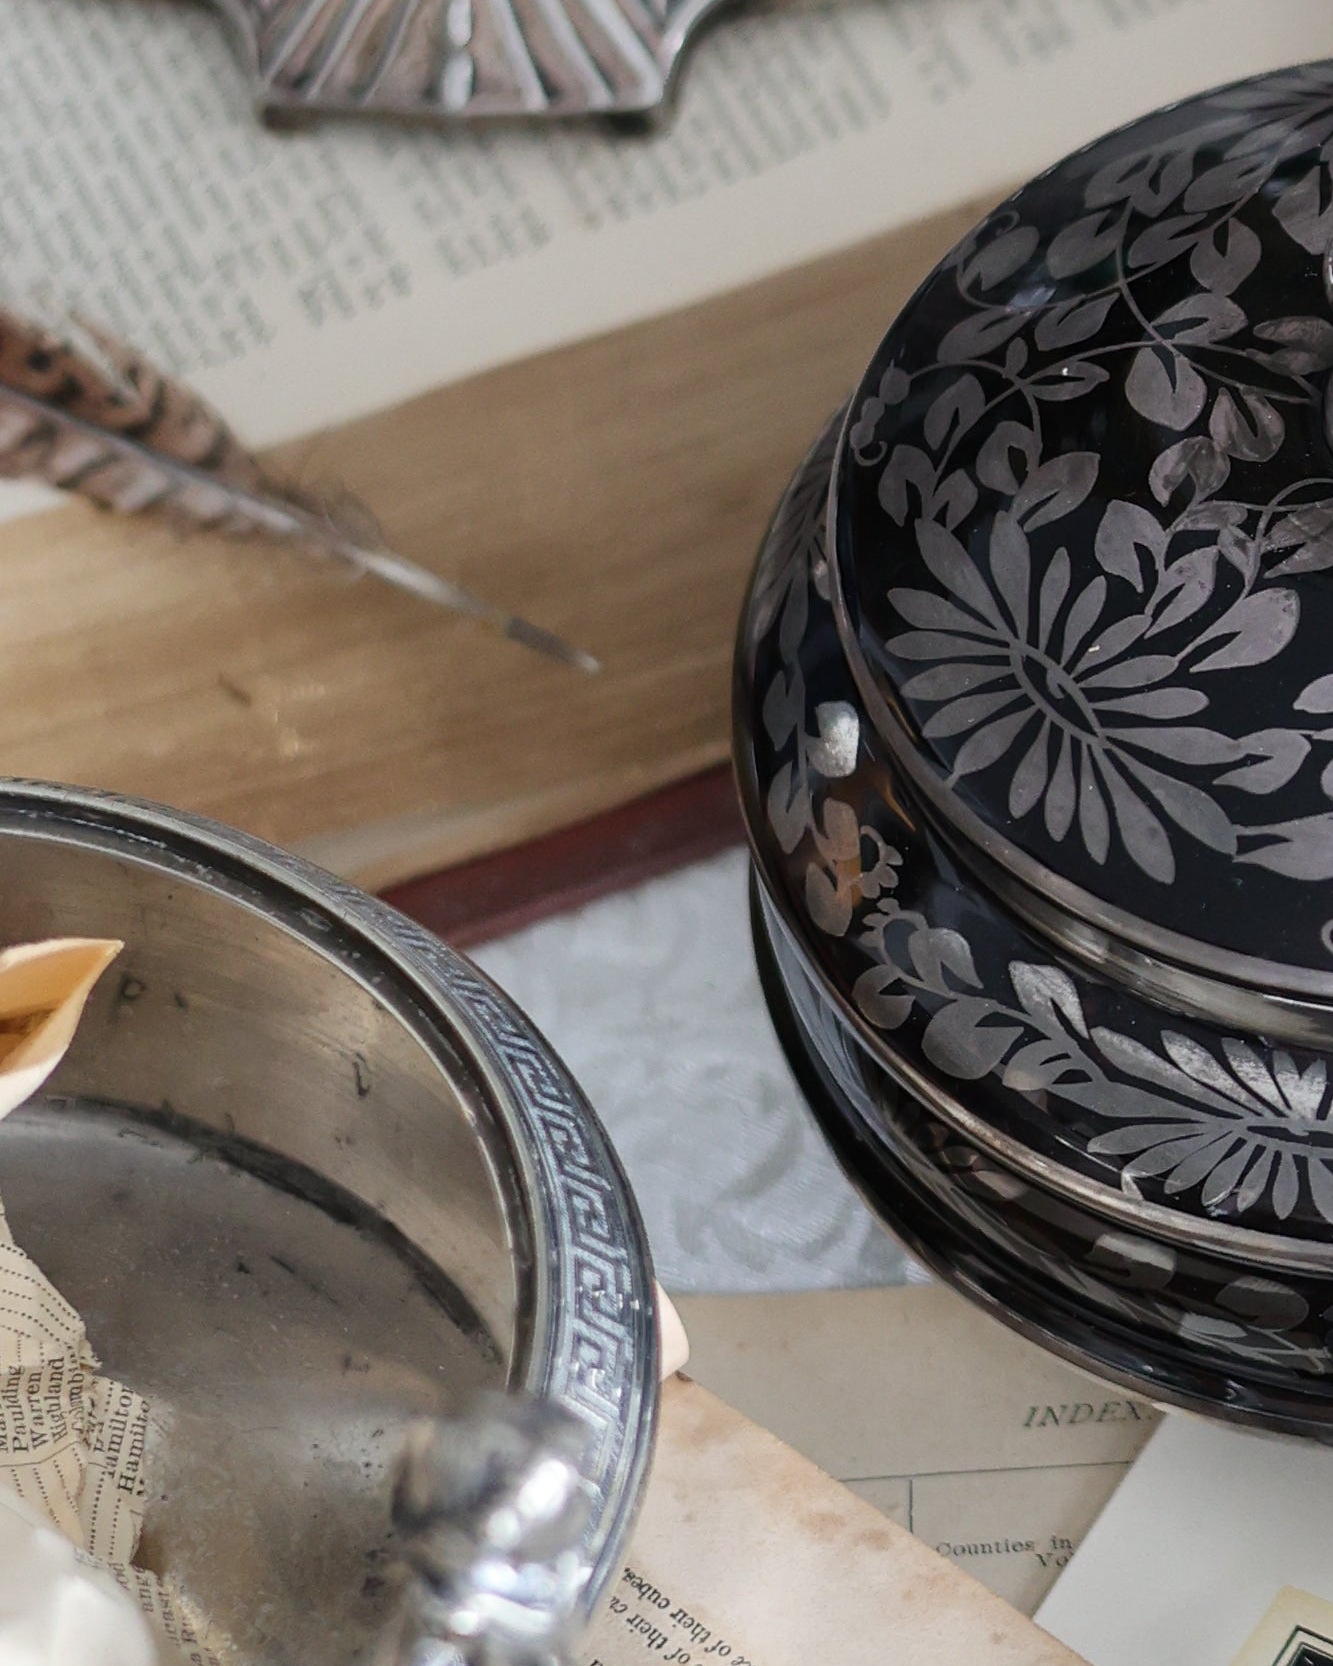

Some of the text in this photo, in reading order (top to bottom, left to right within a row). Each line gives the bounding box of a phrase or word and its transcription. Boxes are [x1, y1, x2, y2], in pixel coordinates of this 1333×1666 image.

[9, 1364, 29, 1453] Paulding
[25, 1371, 49, 1449] Warren
[1050, 1535, 1072, 1550] in
[622, 1567, 671, 1610] cubes.
[625, 1613, 669, 1650] their
[669, 1607, 712, 1644] their
[662, 1647, 692, 1666] of
[703, 1639, 732, 1657] of
